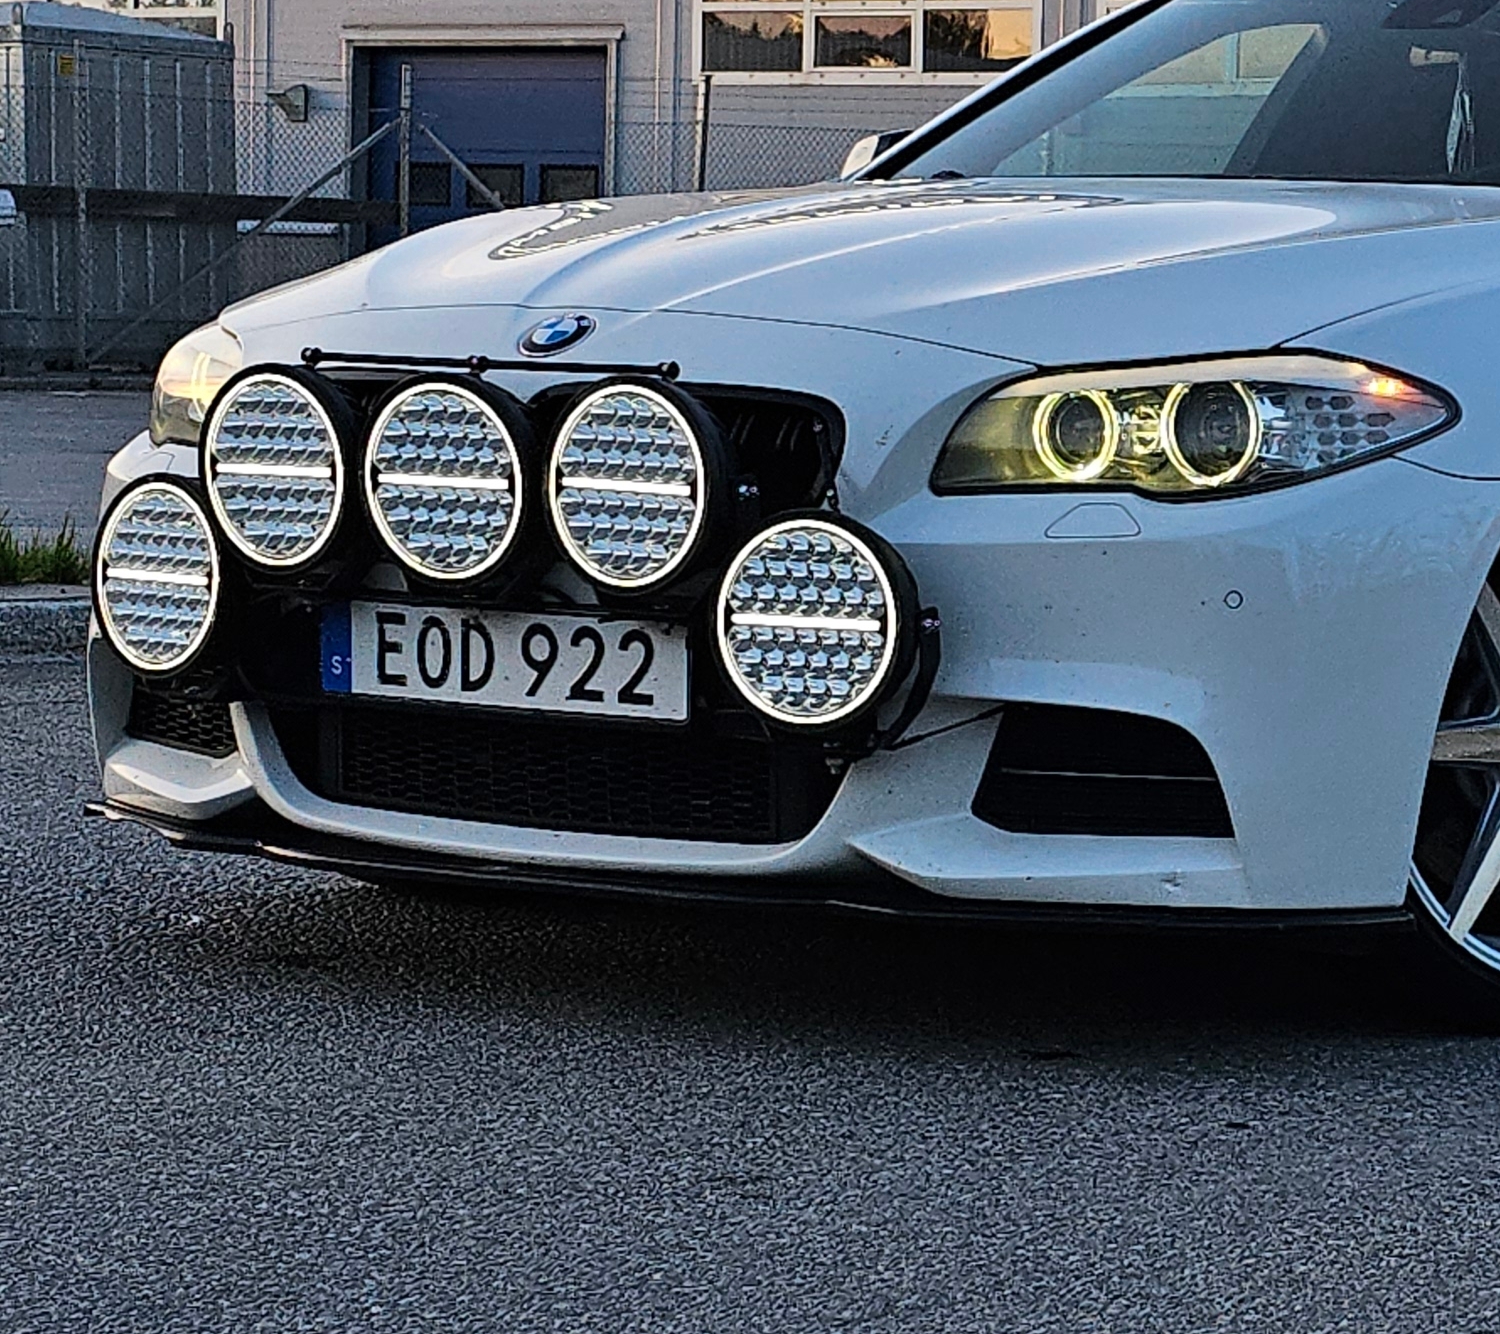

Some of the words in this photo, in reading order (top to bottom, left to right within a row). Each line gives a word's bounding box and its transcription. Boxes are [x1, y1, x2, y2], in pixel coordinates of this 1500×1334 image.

[330, 655, 343, 675] S
[375, 610, 495, 692] EOD
[521, 622, 655, 706] 922
